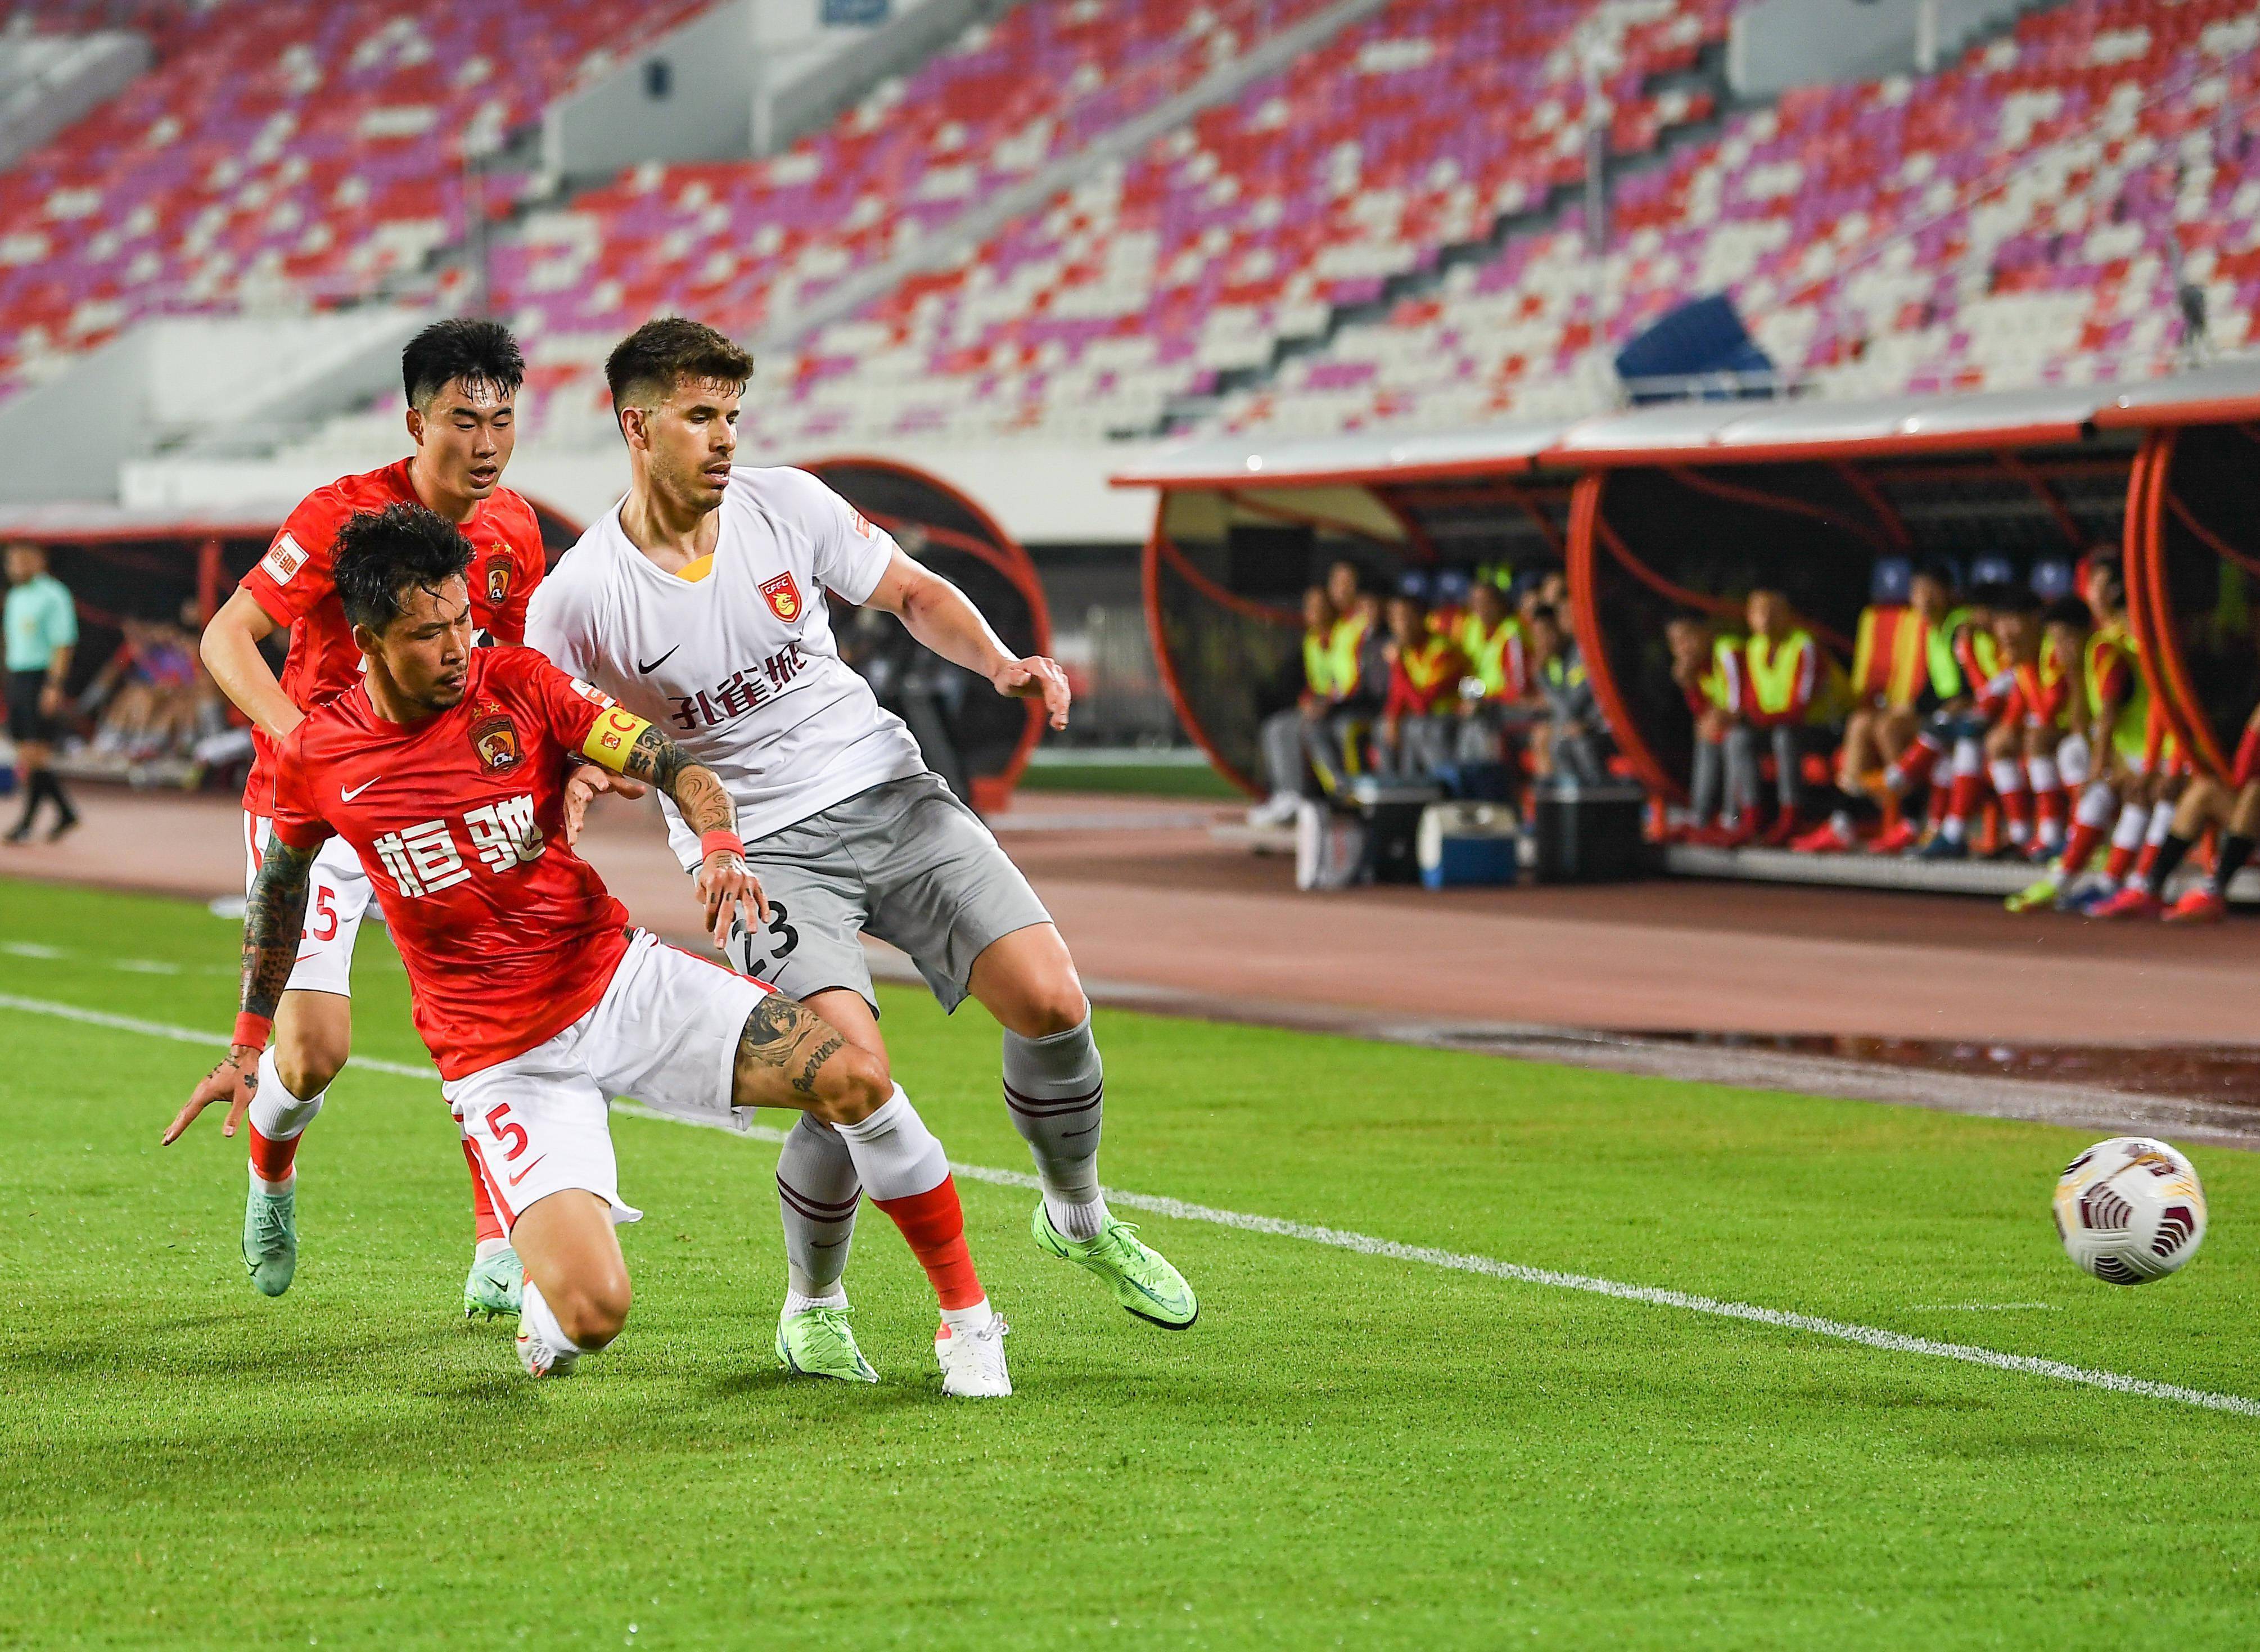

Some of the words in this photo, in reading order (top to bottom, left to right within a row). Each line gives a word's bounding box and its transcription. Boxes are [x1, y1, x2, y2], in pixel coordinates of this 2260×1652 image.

[765, 578, 789, 594] CFFC
[609, 713, 636, 732] C
[372, 793, 547, 899] 恒驰
[301, 884, 339, 941] 5
[732, 900, 799, 977] 23
[485, 1102, 528, 1162] 5
